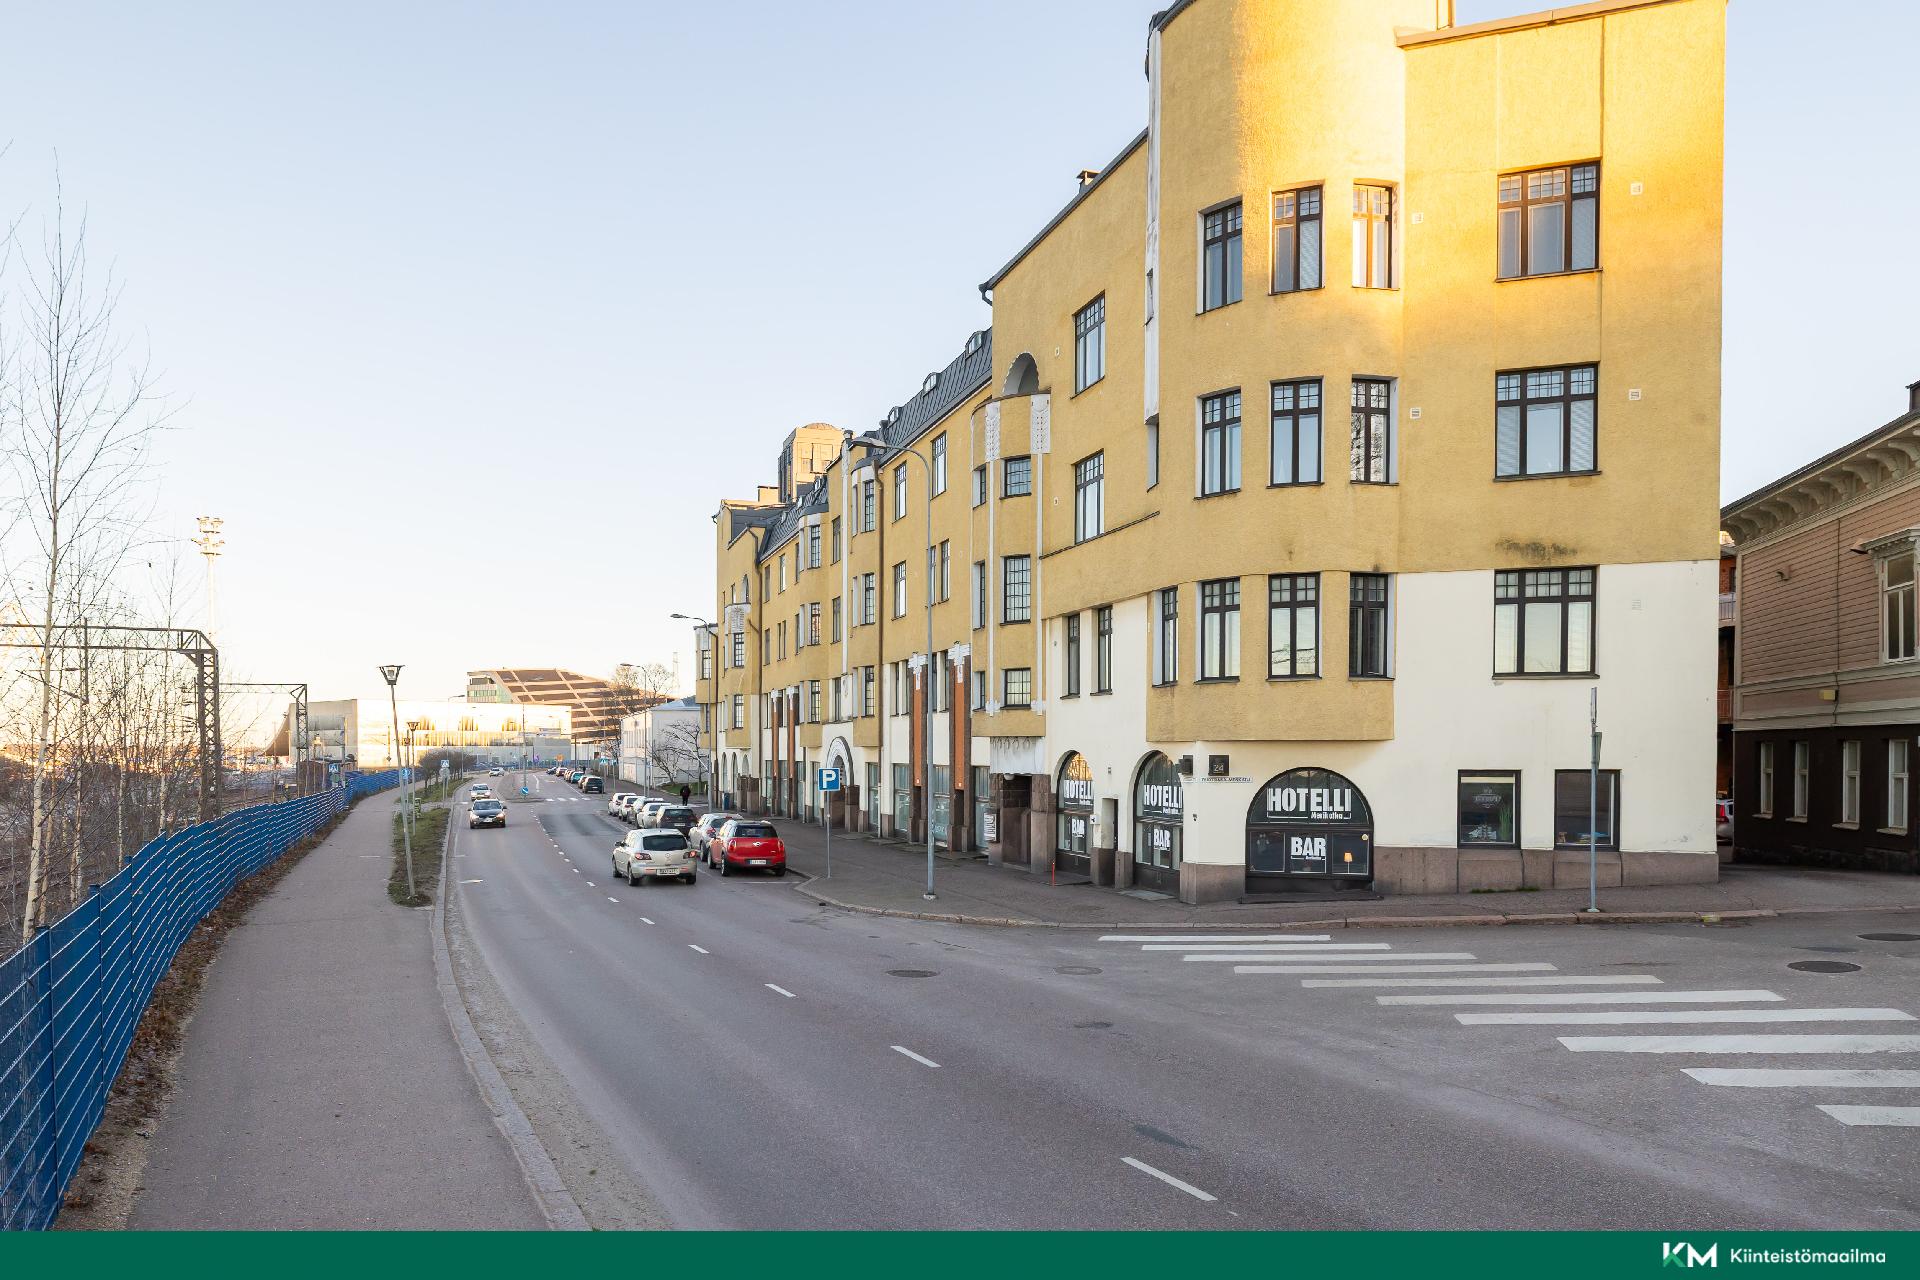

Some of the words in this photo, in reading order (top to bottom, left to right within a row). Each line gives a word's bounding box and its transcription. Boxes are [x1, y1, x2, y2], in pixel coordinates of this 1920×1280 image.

[822, 769, 837, 789] P
[1144, 784, 1183, 809] HOTELLI
[1267, 788, 1351, 812] HOTELLI
[1072, 819, 1085, 835] BAR
[1154, 828, 1171, 848] BAR
[1291, 837, 1326, 856] BAR
